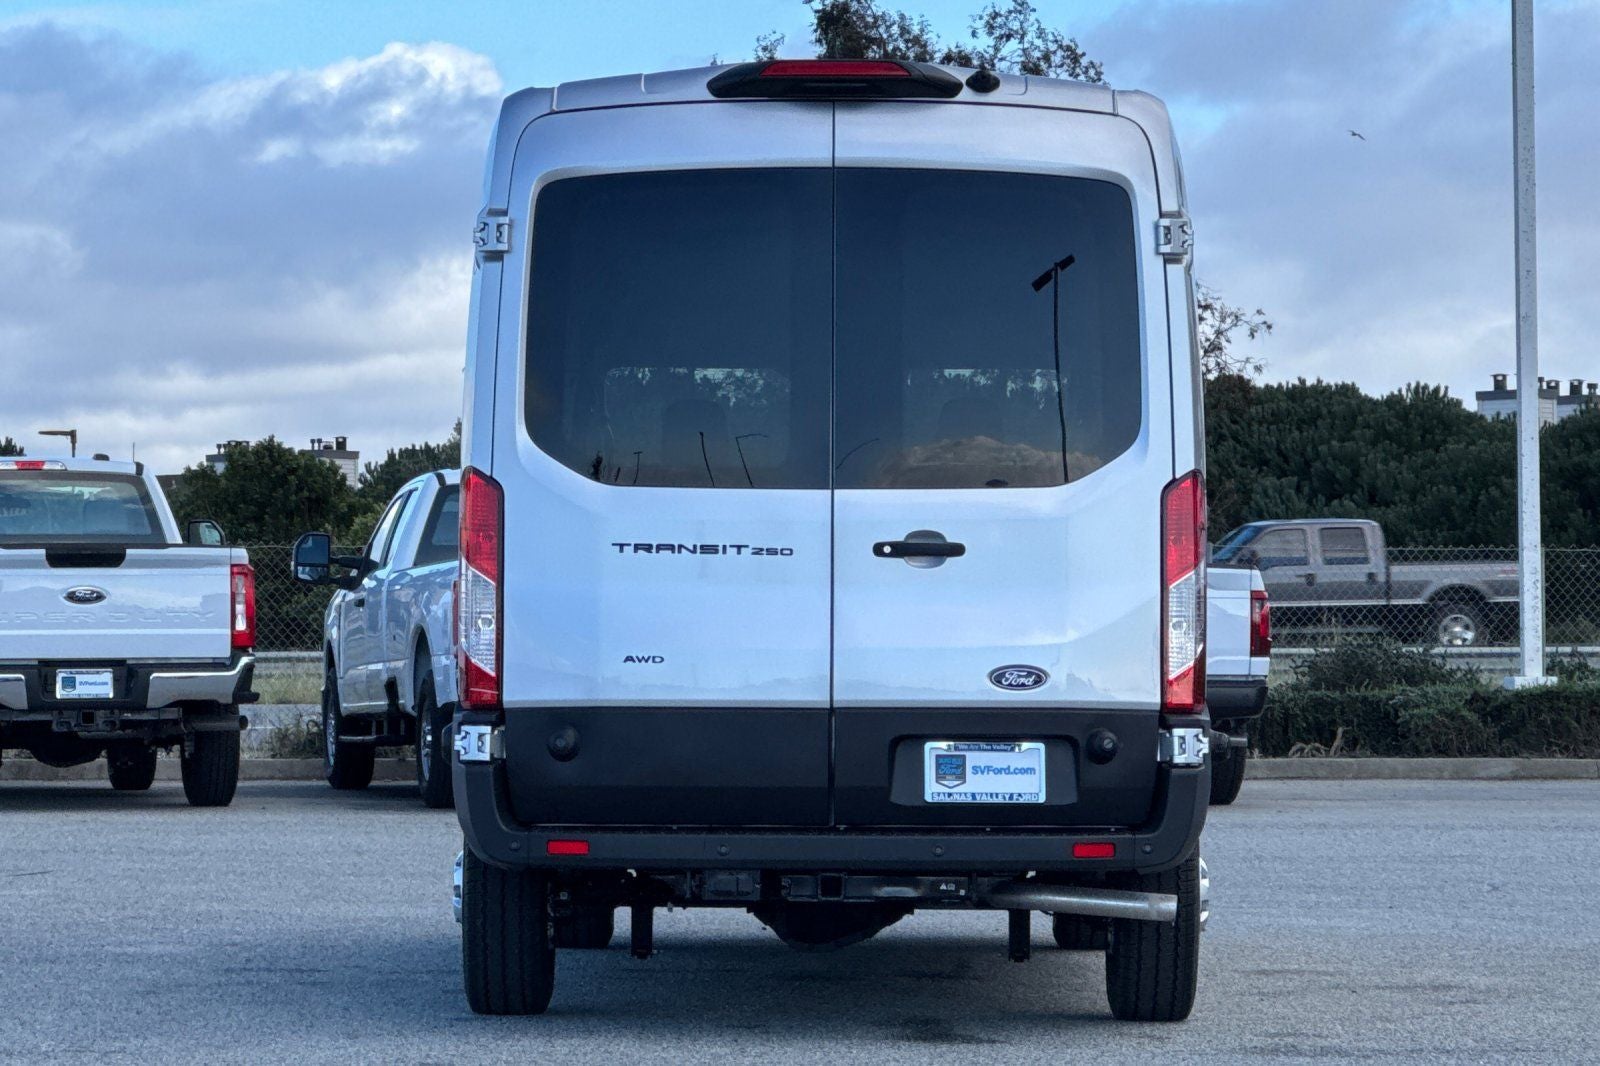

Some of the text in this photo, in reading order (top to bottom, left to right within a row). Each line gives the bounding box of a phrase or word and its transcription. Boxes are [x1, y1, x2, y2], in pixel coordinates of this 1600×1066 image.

[611, 543, 794, 556] TRANSIT 250
[108, 611, 215, 623] DUTY
[623, 655, 665, 664] AWD
[1002, 670, 1036, 686] Ford
[971, 765, 1036, 775] SVFord.com
[976, 792, 1011, 800] VALLEY
